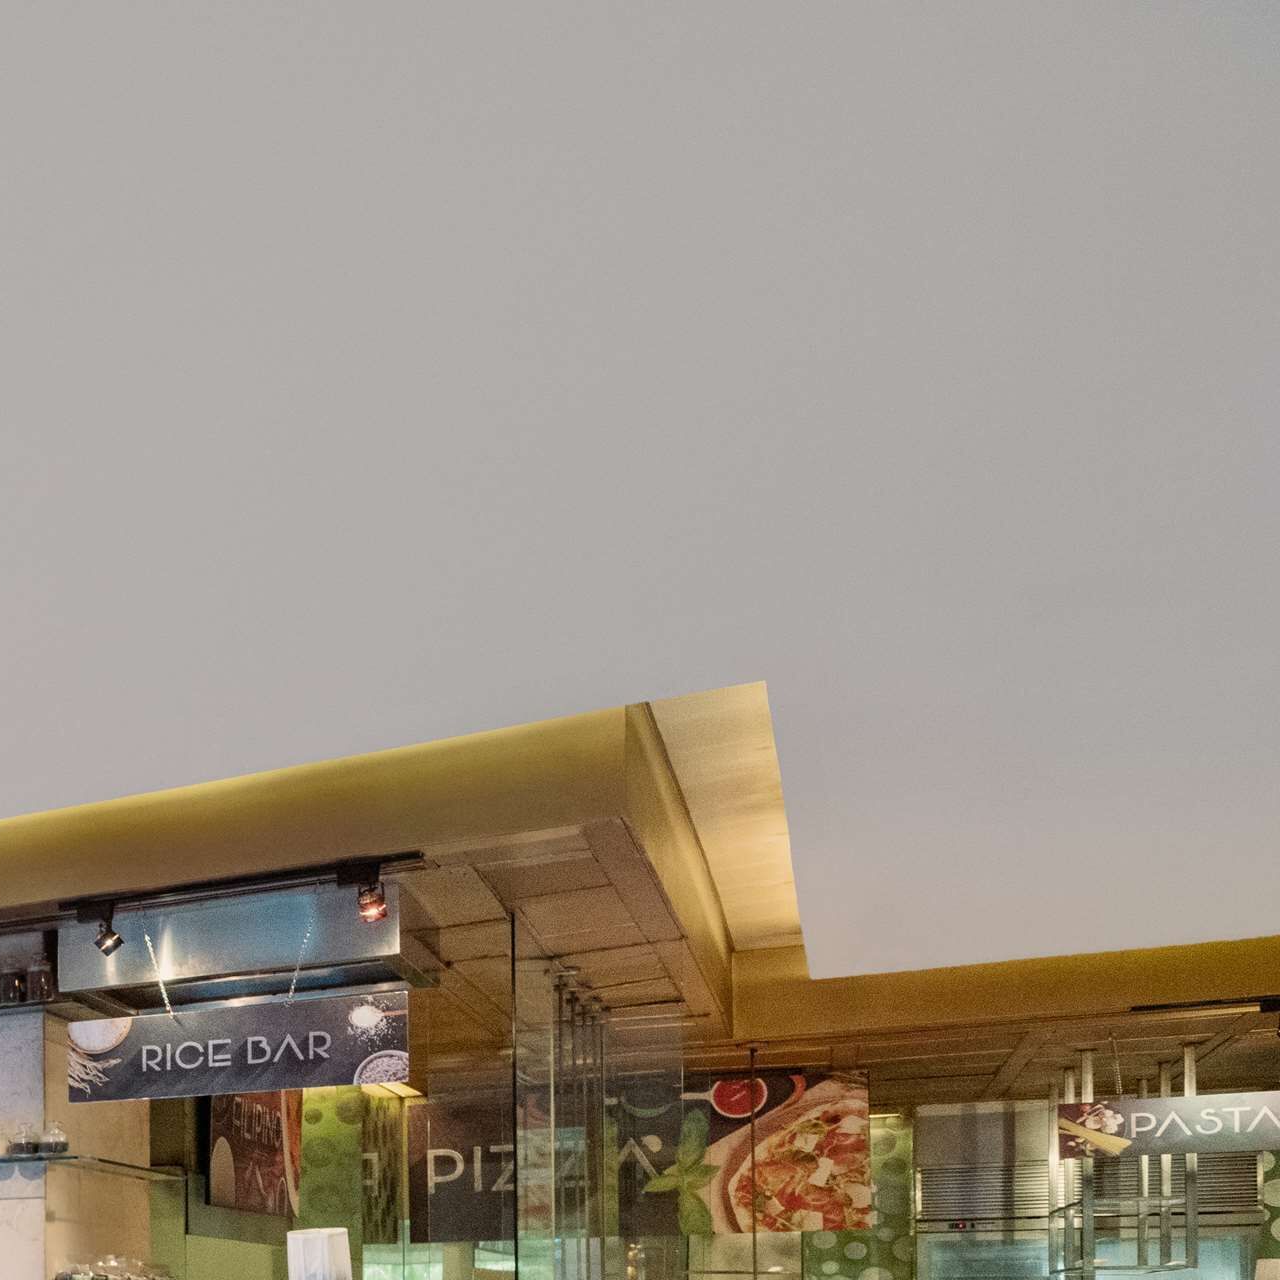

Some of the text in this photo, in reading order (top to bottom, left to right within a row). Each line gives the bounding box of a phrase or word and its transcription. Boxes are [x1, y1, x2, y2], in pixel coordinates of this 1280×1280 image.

[142, 1030, 332, 1072] RICE BAR
[232, 1096, 283, 1149] FILIPINO
[1130, 1105, 1280, 1138] PASTA
